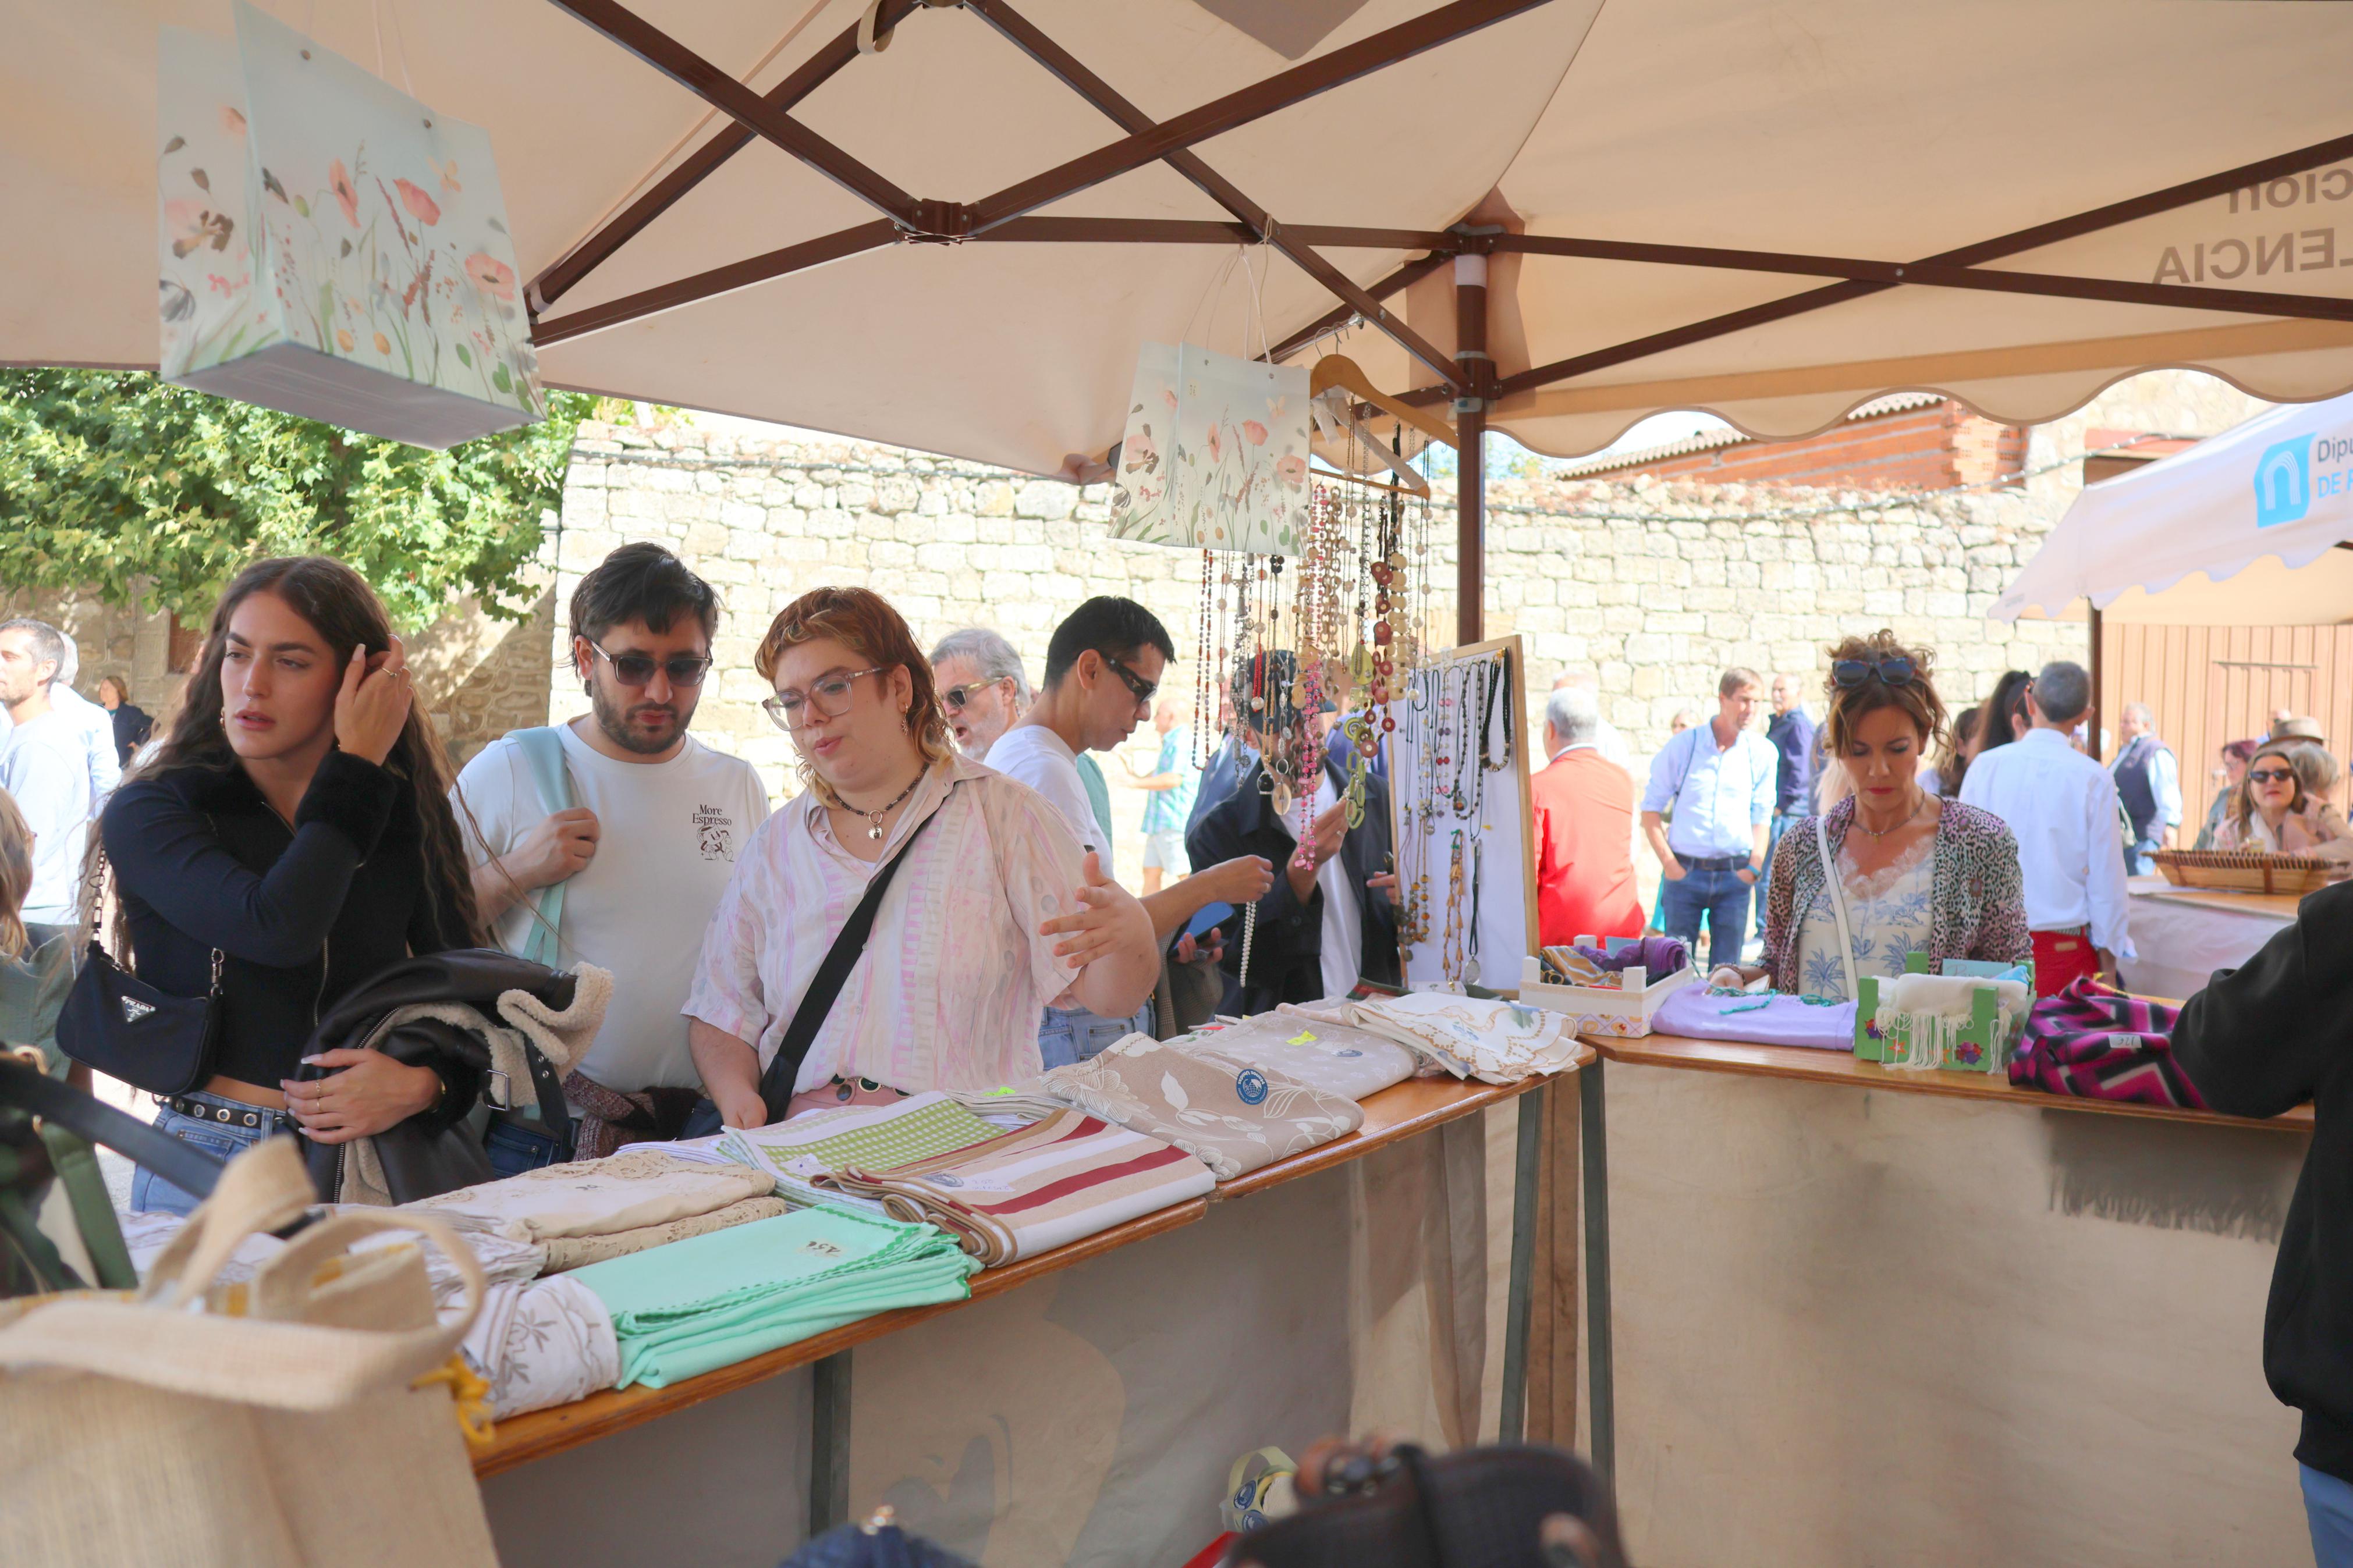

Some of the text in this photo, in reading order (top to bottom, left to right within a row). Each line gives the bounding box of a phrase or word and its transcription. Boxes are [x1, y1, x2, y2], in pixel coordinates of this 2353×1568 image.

[2317, 471, 2343, 499] DE
[699, 804, 722, 816] More
[692, 813, 732, 826] Espresso
[125, 999, 150, 1012] PRADA
